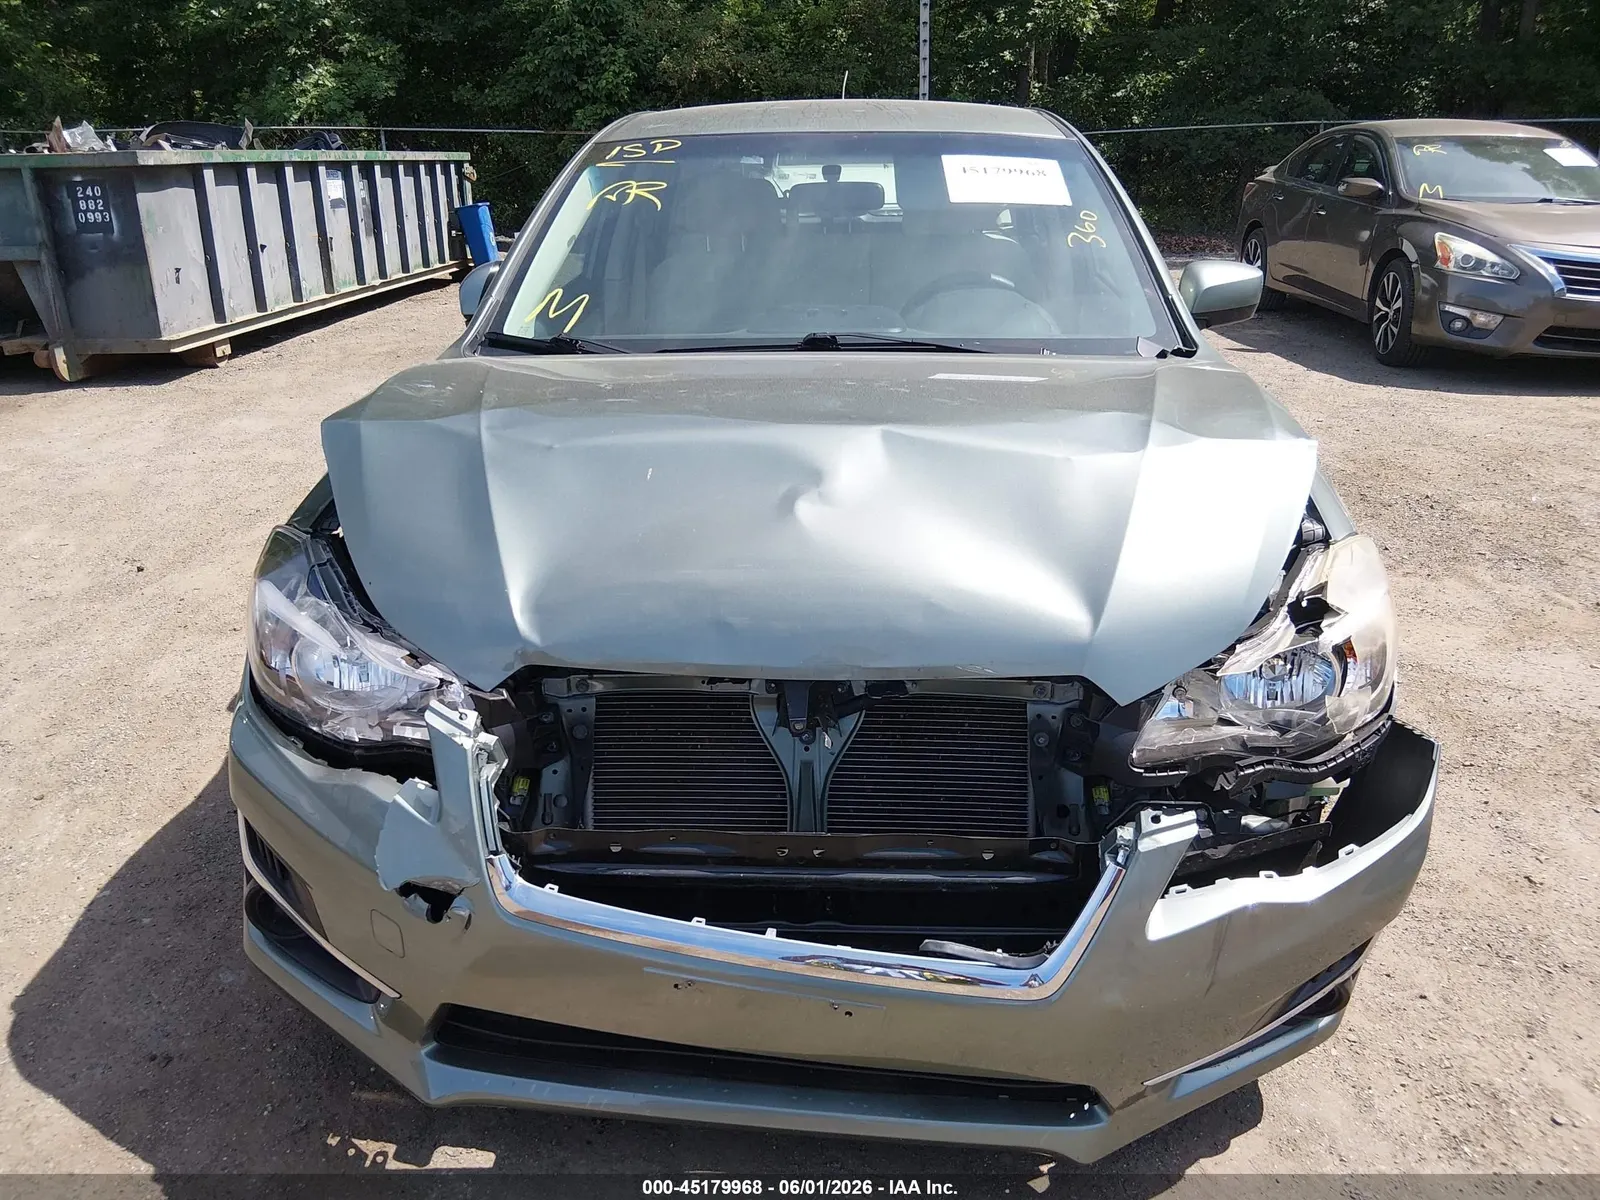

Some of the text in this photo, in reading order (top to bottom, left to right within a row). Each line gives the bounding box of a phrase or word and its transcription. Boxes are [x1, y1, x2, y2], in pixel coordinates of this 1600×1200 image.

[76, 186, 101, 197] 240
[79, 199, 104, 210] 882
[78, 212, 110, 222] 0993
